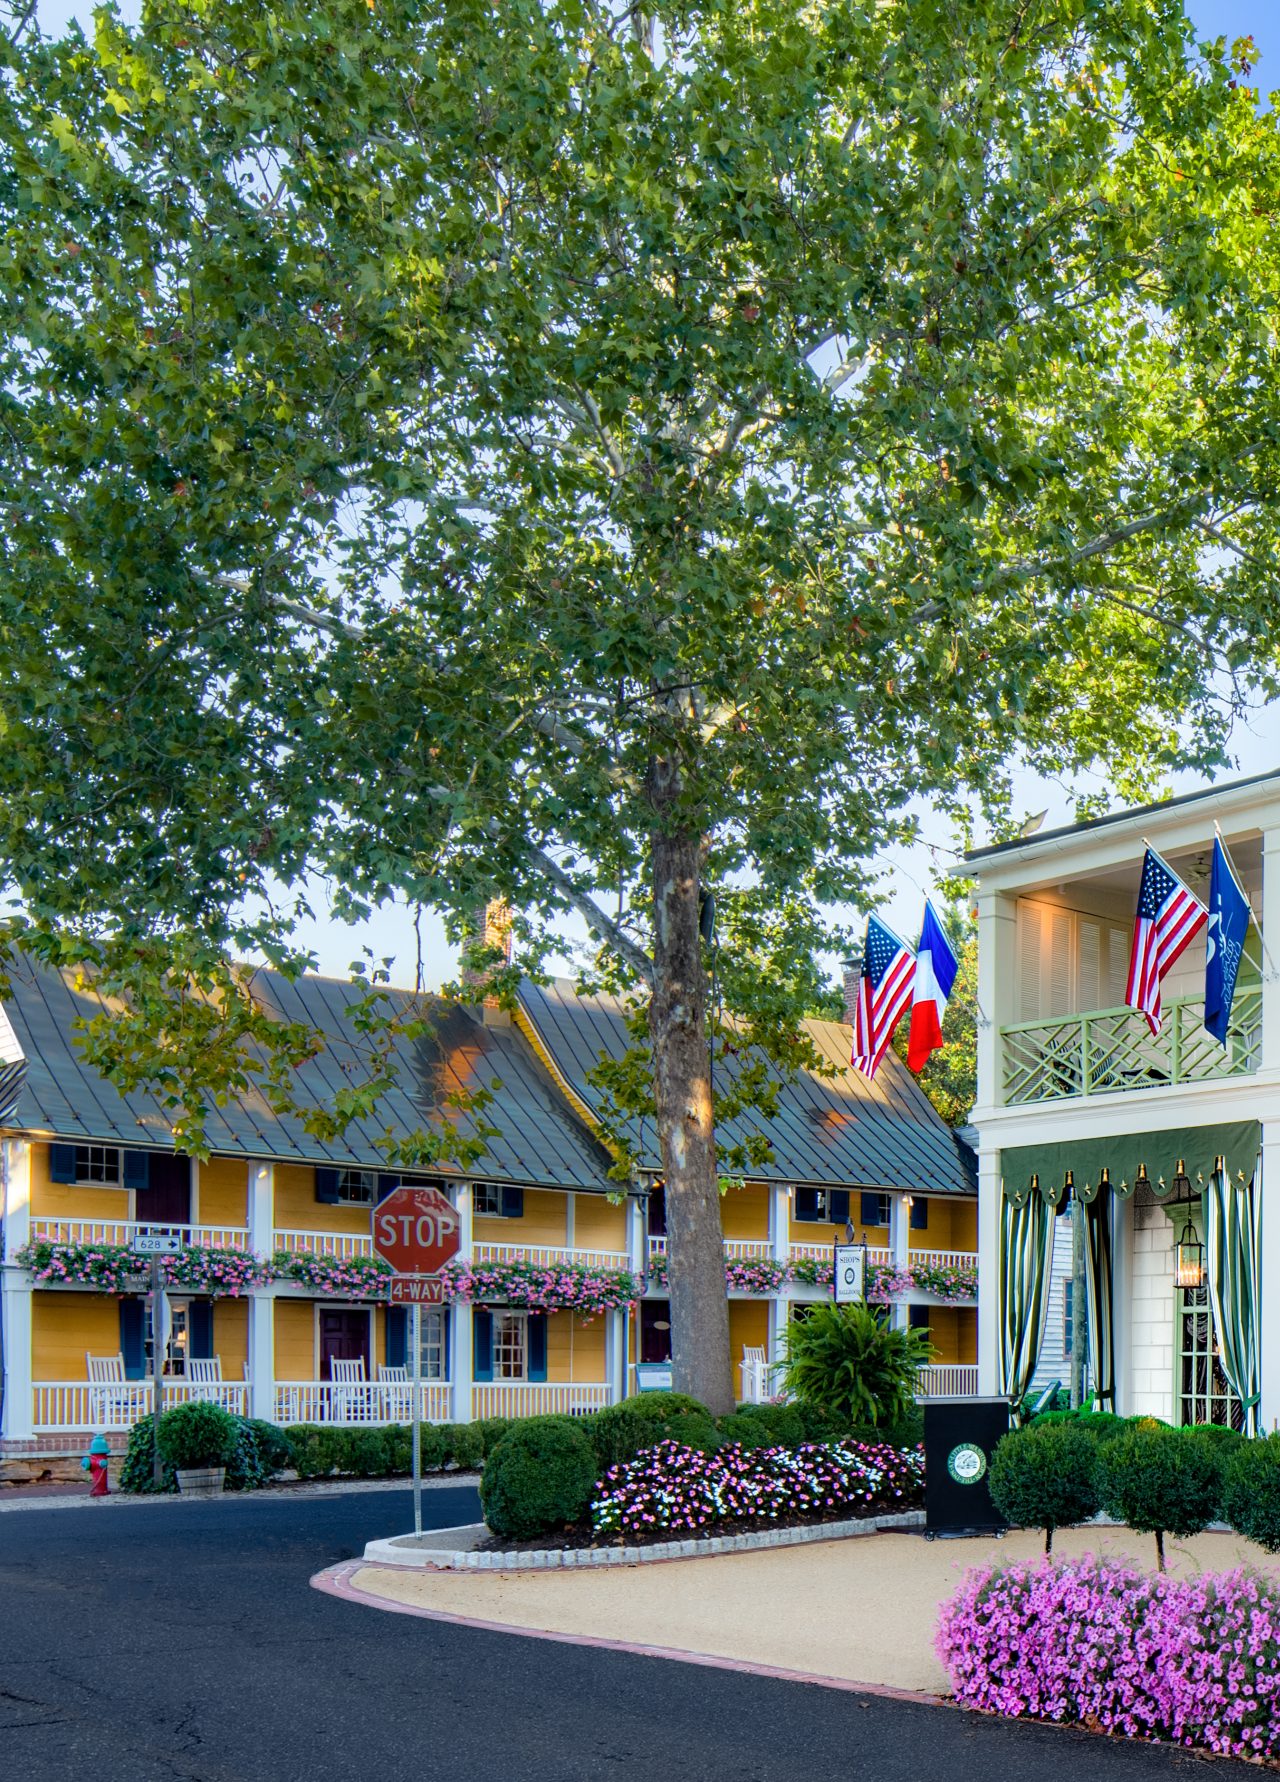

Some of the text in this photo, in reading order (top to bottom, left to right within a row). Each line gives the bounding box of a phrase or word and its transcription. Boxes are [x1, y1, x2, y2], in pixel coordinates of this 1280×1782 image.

[379, 1215, 455, 1247] STOP
[140, 1240, 161, 1249] 628
[392, 1283, 441, 1300] 4-WAY
